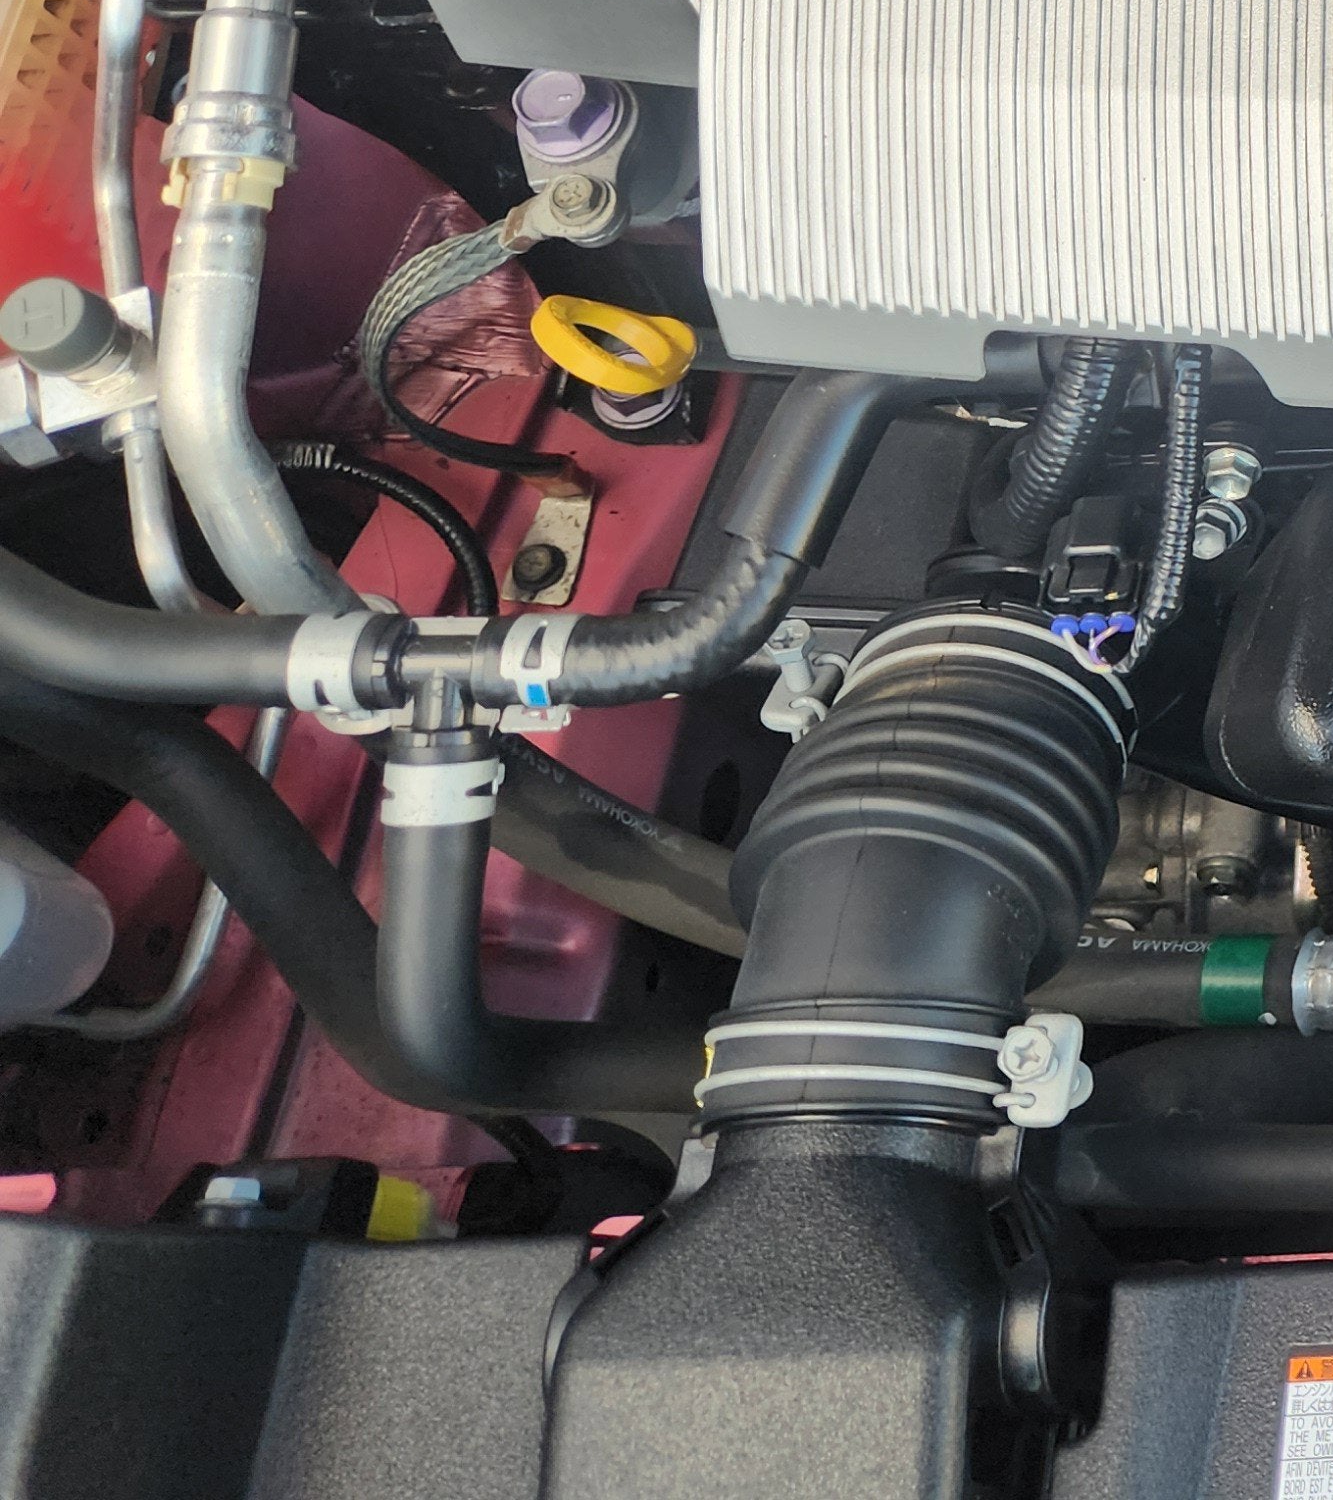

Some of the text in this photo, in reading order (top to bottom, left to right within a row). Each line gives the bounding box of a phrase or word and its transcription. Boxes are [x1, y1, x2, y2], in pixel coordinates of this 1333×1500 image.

[578, 785, 658, 840] YOKOHAMA
[1290, 1416, 1305, 1429] TO
[1288, 1430, 1309, 1443] THE
[1287, 1443, 1307, 1457] SEE
[1284, 1461, 1303, 1477] AFIN
[1283, 1478, 1306, 1495] BORD
[1309, 1477, 1323, 1493] EST
